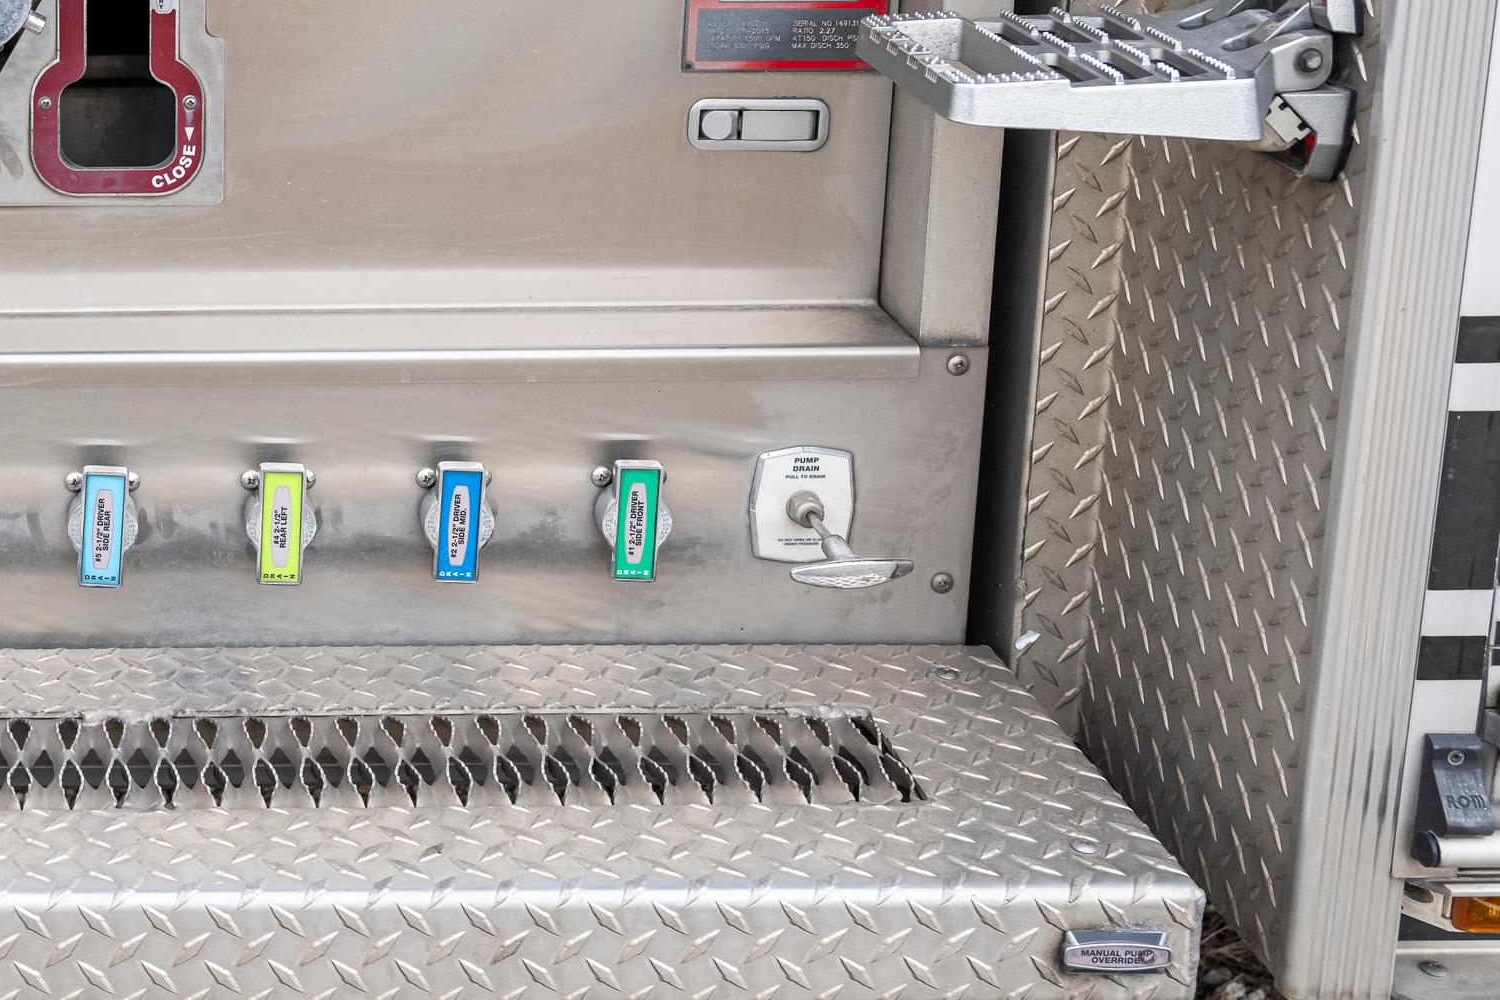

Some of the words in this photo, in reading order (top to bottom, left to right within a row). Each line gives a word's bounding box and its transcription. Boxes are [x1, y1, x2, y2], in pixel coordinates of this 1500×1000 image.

[151, 145, 196, 188] CLOSE
[97, 498, 105, 526] DRIVER
[452, 494, 461, 522] DRIVER
[630, 490, 638, 519] DRIVER
[636, 501, 644, 526] FRONT
[274, 534, 280, 544] #4
[458, 526, 466, 545] SIDE
[450, 548, 458, 558] #2
[628, 548, 634, 556] #1
[1091, 956, 1140, 964] OVERRIDE
[1124, 950, 1152, 958] PUMP
